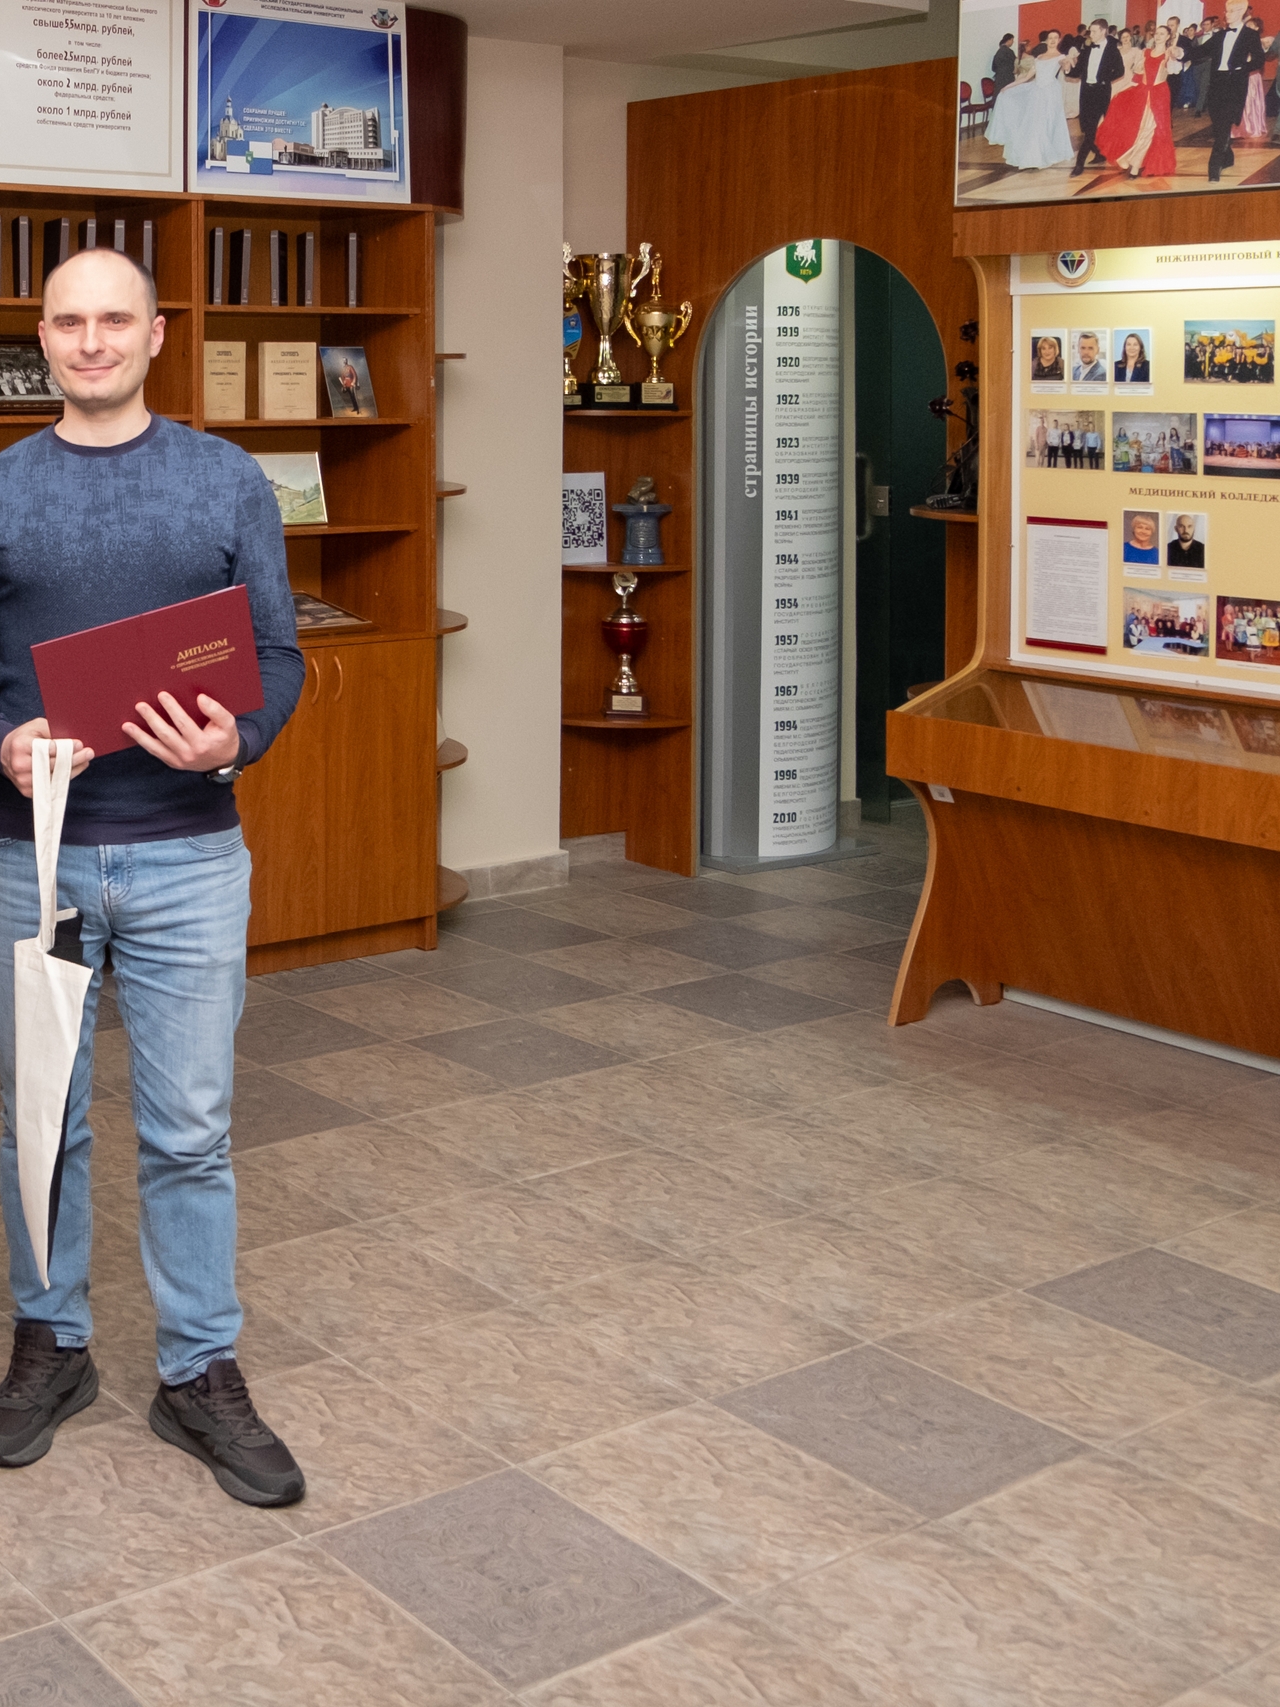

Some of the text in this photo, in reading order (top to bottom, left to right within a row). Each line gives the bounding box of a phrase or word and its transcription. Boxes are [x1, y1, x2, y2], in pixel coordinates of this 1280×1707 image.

[21, 4, 61, 14] классического
[62, 9, 98, 18] университета
[33, 18, 64, 29] свыше
[74, 23, 100, 34] млрд.
[102, 25, 135, 37] рублей,
[36, 49, 64, 61] более
[74, 55, 99, 66] млрд.
[101, 56, 132, 68] рублей
[37, 77, 133, 95] около 2 млрд. рублей
[37, 106, 132, 122] около 1 млрд. рублей
[1156, 250, 1272, 263] ИНЖИНИРИНГОВЫЙ
[777, 306, 800, 317] 1876
[777, 326, 799, 337] 1919
[776, 356, 800, 367] 1920
[744, 306, 762, 498] страницы истории
[776, 394, 800, 405] 1922
[776, 437, 800, 448] 1923
[776, 473, 800, 485] 1939
[1129, 487, 1280, 503] МЕДИЦИНСКИЙ КОЛЛЕДЖ
[775, 510, 798, 521] 1941
[775, 554, 799, 565] 1944
[775, 598, 798, 609] 1954
[775, 634, 798, 646] 1957
[177, 637, 228, 662] ДИПЛОМ
[774, 685, 798, 696] 1967
[774, 720, 797, 731] 1994
[774, 769, 797, 780] 1996
[773, 812, 797, 823] 2010
